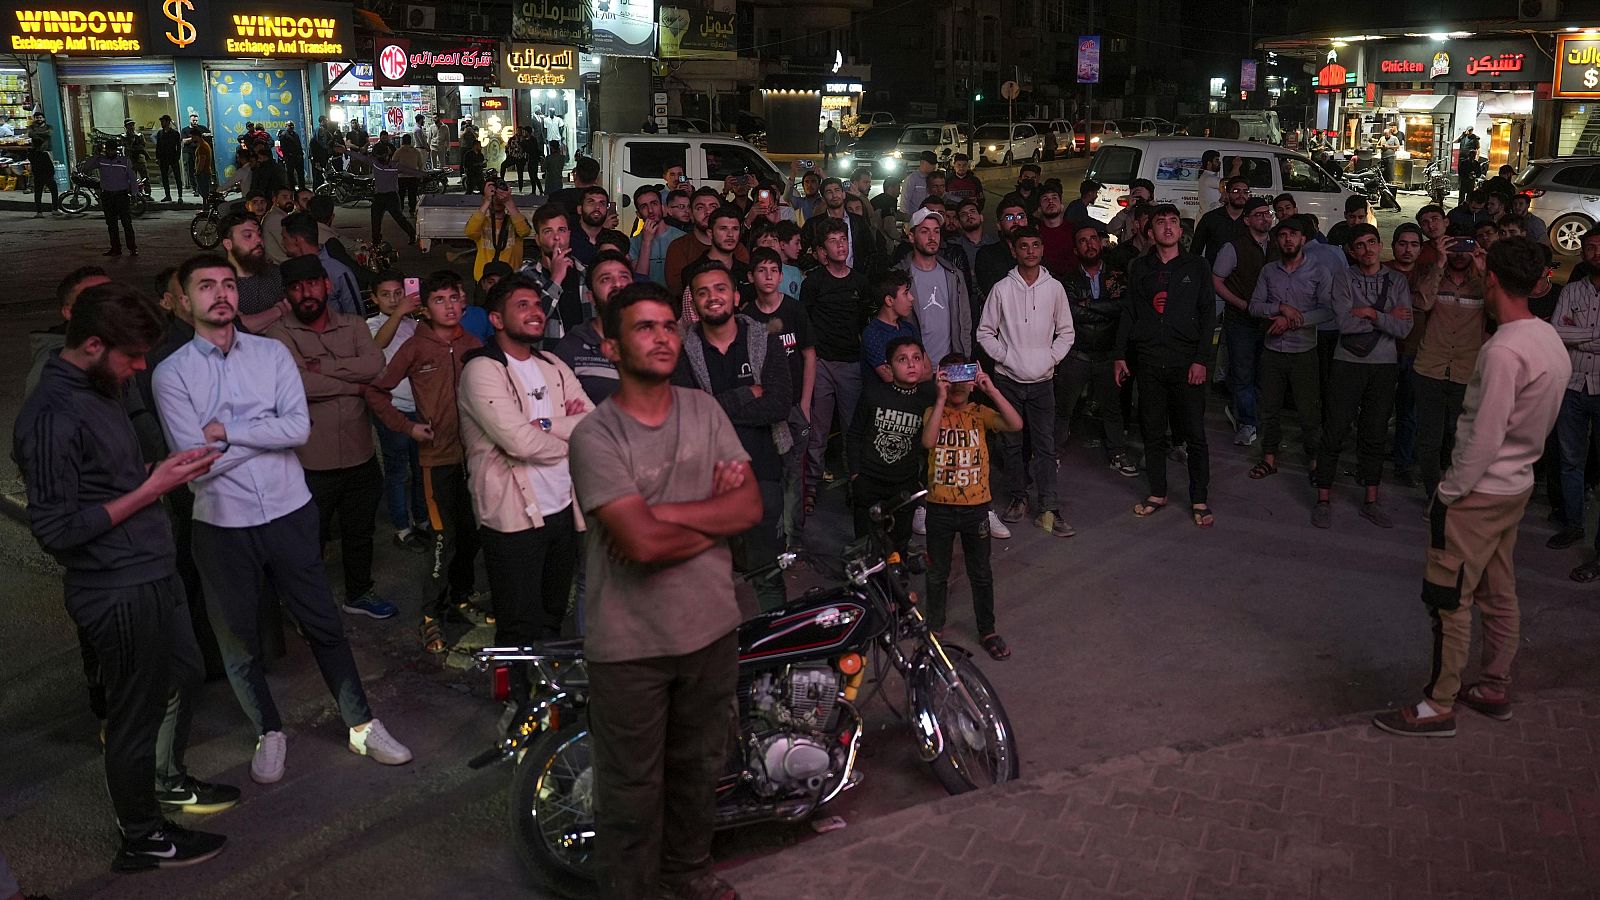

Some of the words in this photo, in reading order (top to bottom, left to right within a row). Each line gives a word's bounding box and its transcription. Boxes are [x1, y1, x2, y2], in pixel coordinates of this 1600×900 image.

[15, 10, 134, 34] WINDOW
[232, 14, 336, 38] WINDOW
[11, 35, 64, 53] Exchange
[65, 35, 87, 50] And
[88, 36, 141, 51] Transfers
[226, 38, 276, 56] Exchange
[277, 39, 297, 53] And
[298, 40, 343, 54] Transfers
[461, 51, 492, 68] شركة
[506, 48, 573, 73] السرماني
[1381, 59, 1425, 73] Chicken
[1466, 53, 1525, 76] تشيكن
[826, 83, 848, 93] ENJOY
[936, 428, 980, 448] BORN
